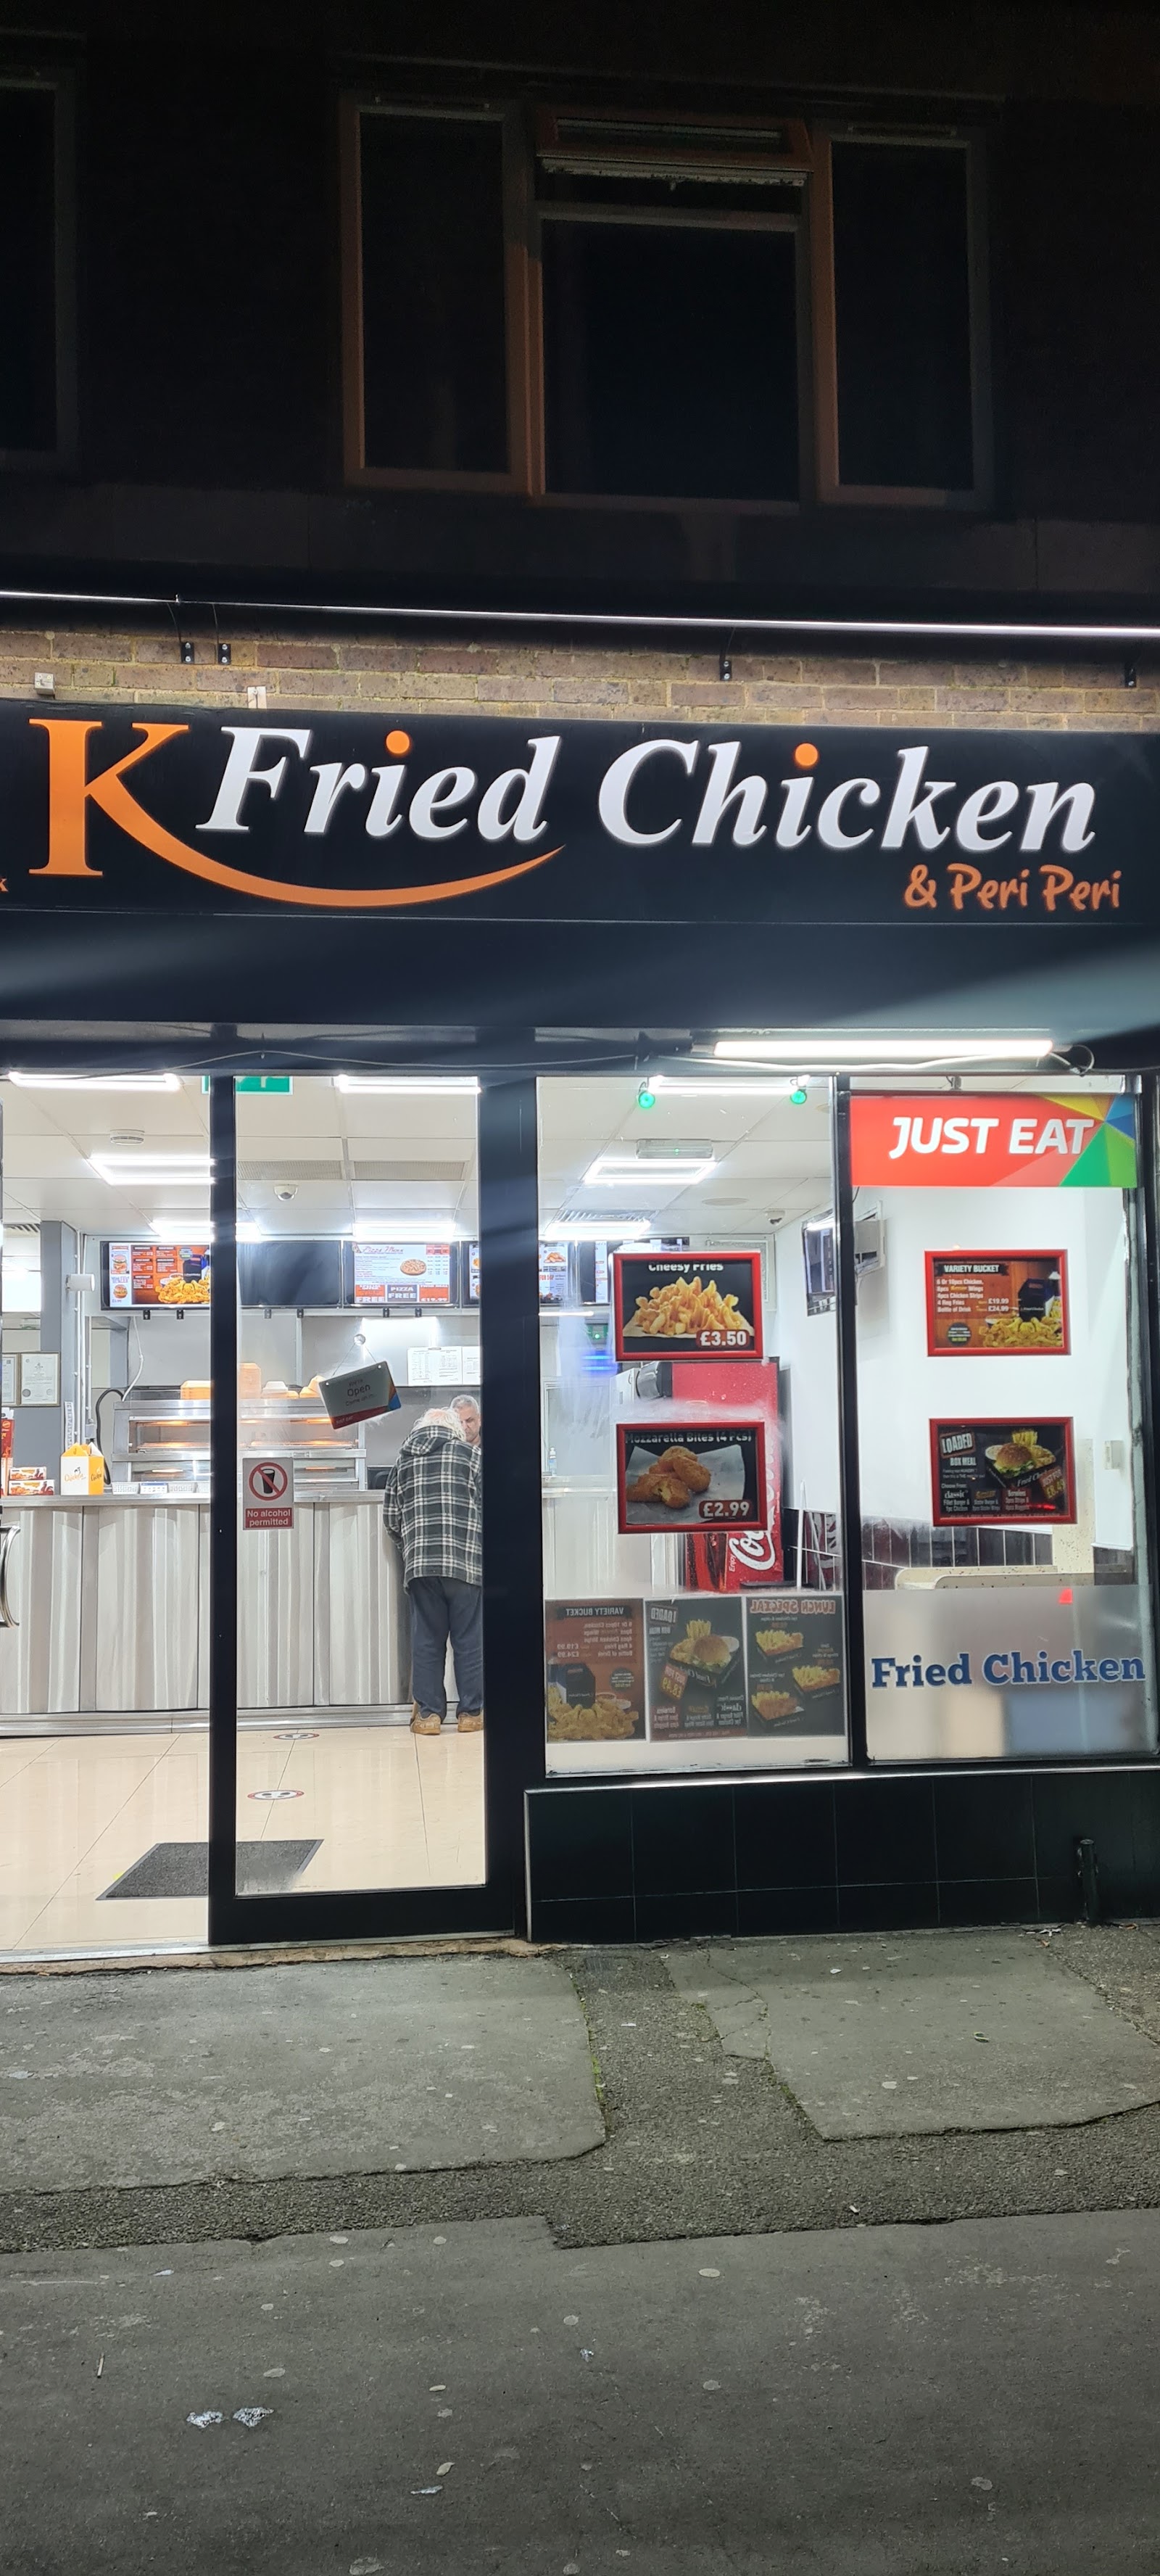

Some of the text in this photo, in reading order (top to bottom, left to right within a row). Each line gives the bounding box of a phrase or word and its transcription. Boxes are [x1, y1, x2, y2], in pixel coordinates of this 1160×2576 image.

[195, 726, 561, 841] Fried
[598, 738, 1095, 852] Chicken
[904, 863, 1122, 912] & Peri Peri
[889, 1117, 1095, 1159] JUST EAT
[648, 1263, 724, 1273] Cheesy Fries
[700, 1331, 747, 1347] £3.50
[347, 1384, 370, 1398] Open
[625, 1432, 684, 1444] Mozzarella
[686, 1432, 714, 1442] Bites
[729, 1430, 752, 1442] Pcs)
[942, 1433, 972, 1453] LOADED
[703, 1501, 750, 1517] £2.99
[249, 1517, 289, 1528] permitted
[870, 1648, 1147, 1689] Fried Chicken
